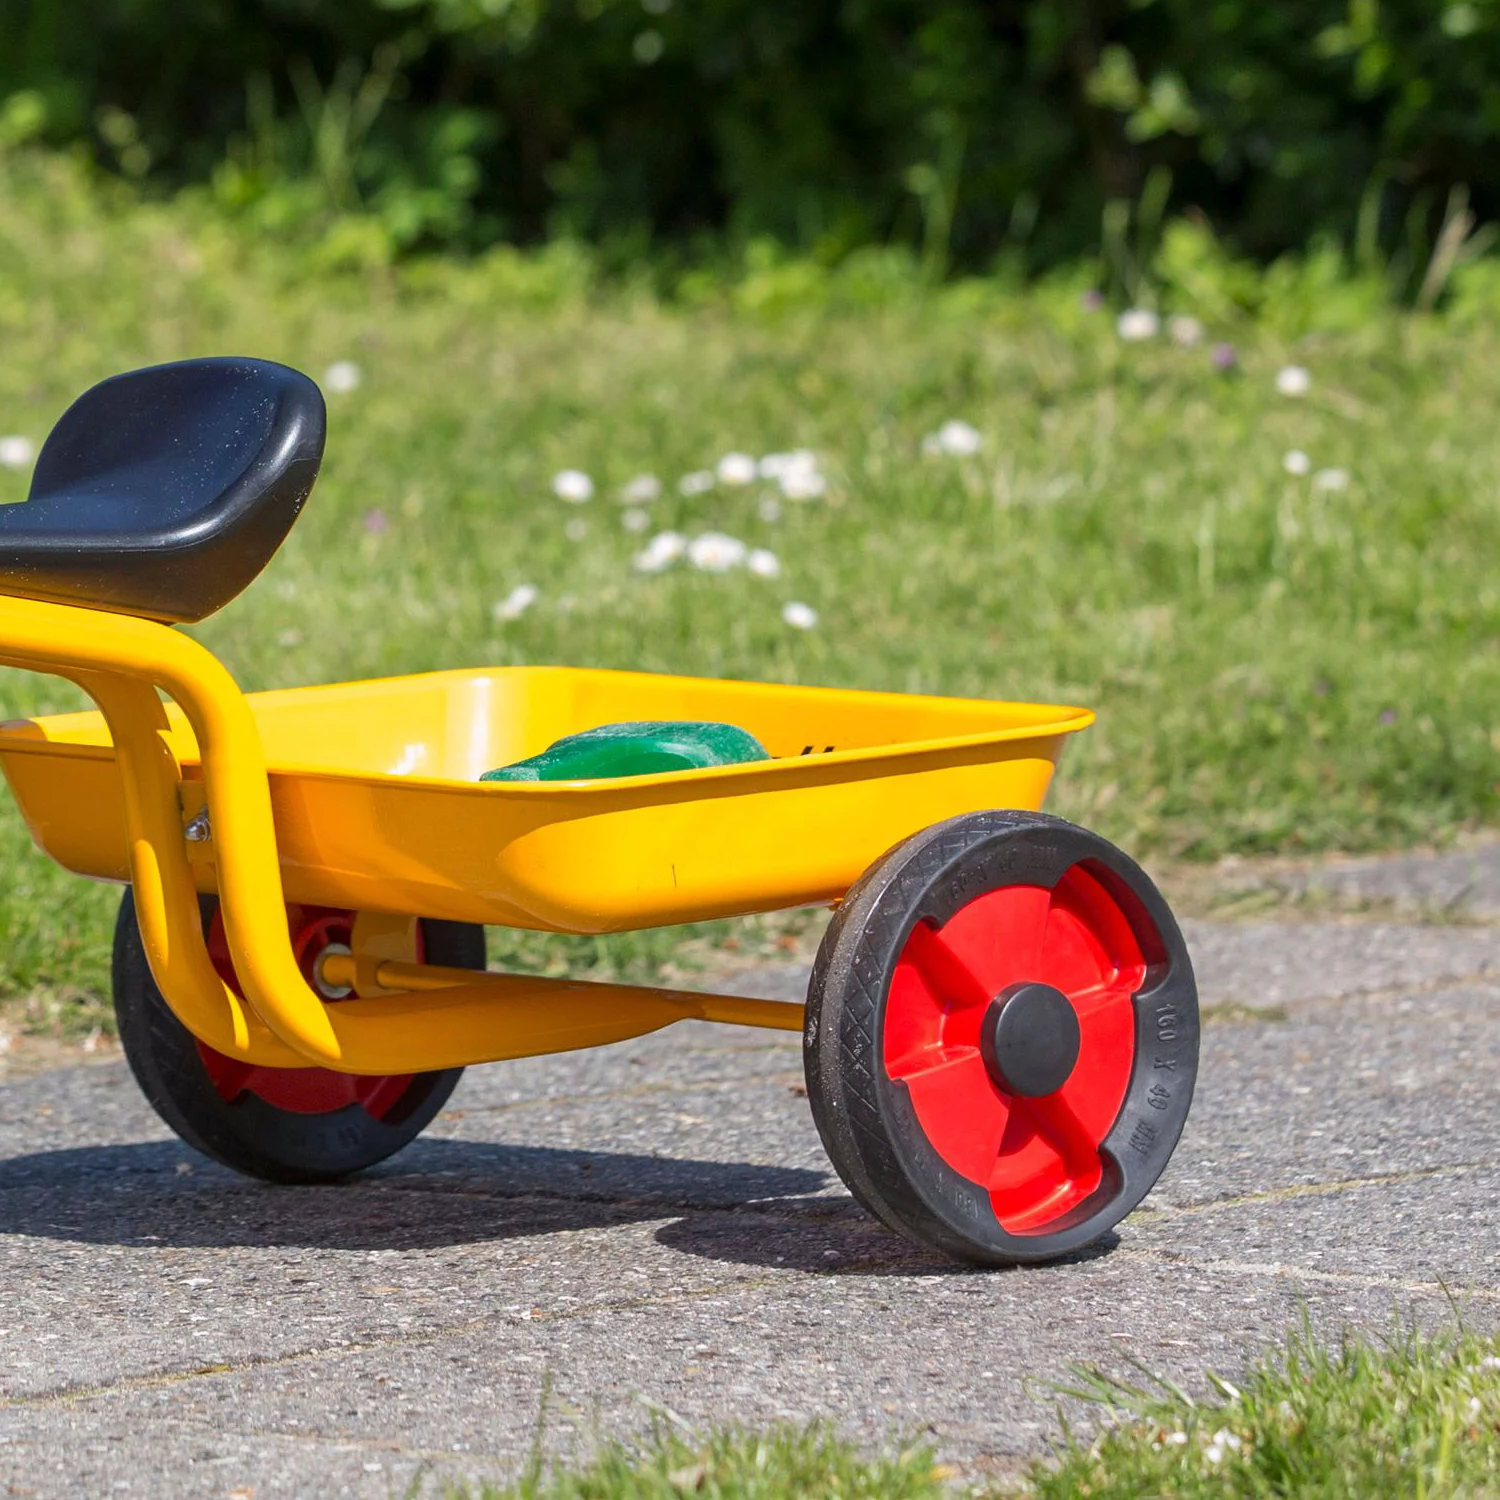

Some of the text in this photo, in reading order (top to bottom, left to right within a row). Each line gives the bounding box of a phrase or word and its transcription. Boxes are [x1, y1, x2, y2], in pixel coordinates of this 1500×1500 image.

[1155, 1003, 1179, 1042] 160
[1153, 1056, 1178, 1072] X
[1147, 1083, 1172, 1111] 40
